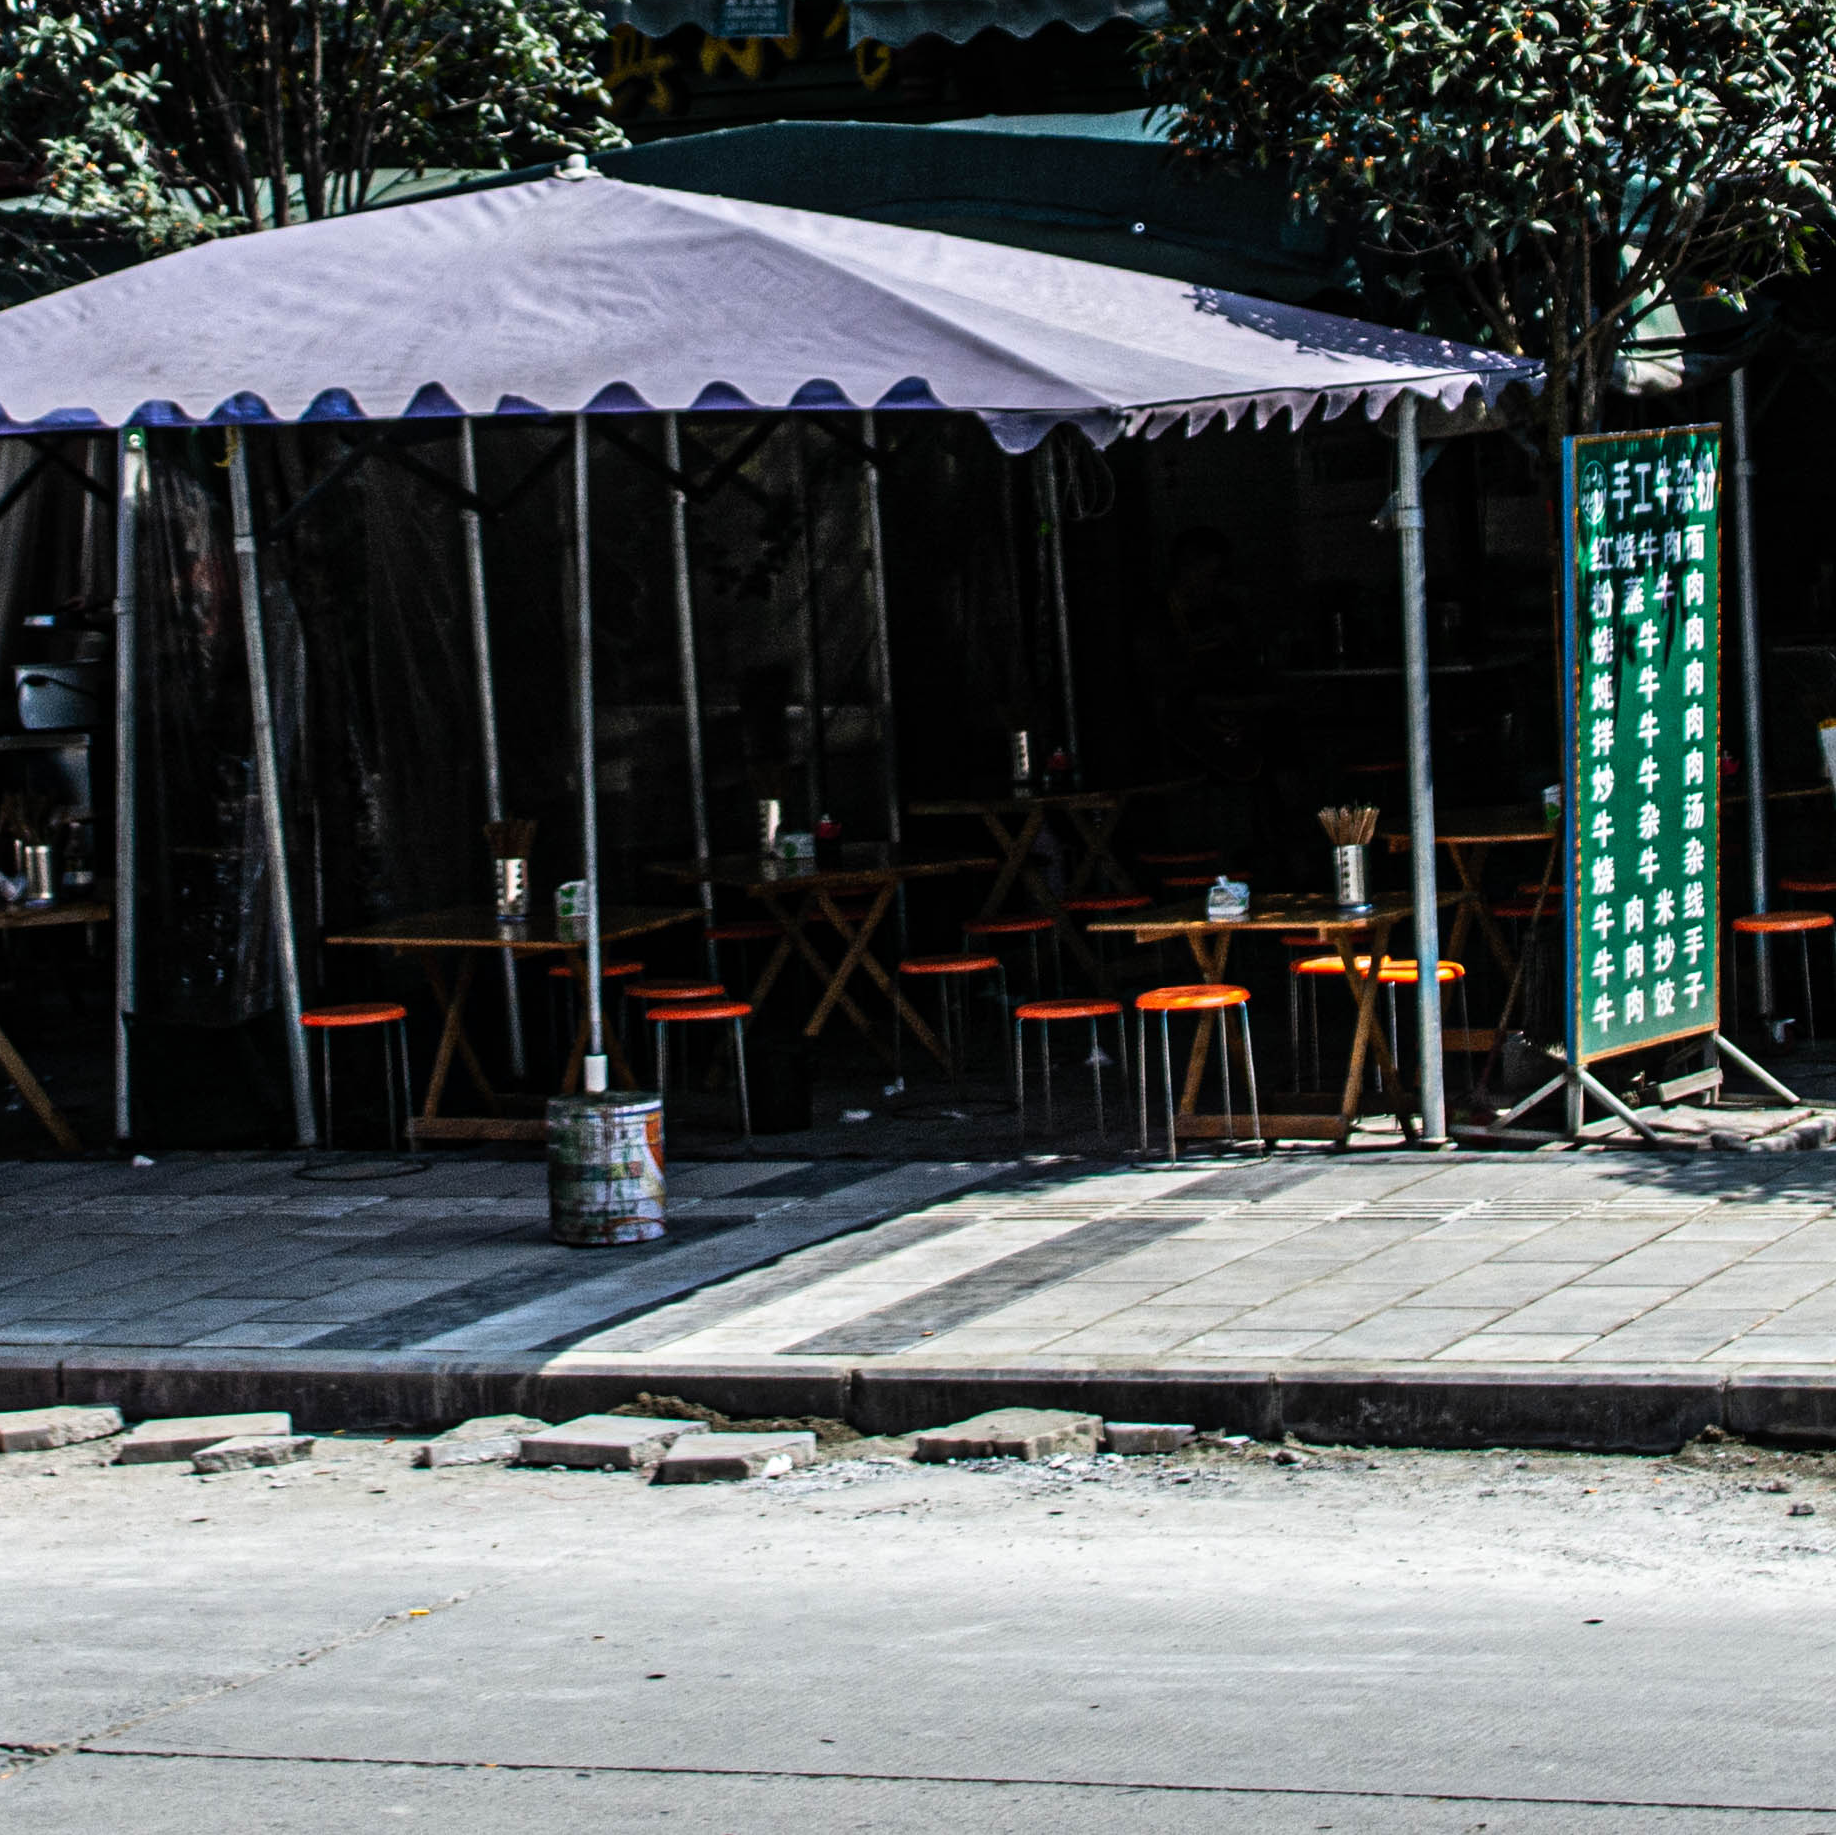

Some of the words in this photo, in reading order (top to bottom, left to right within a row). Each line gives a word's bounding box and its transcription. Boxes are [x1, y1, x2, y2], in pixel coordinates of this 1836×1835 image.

[1612, 451, 1716, 521] 手工牛杂粉
[1589, 524, 1706, 572] 红烧牛肉面
[1589, 568, 1706, 619] 粉蒸牛肉
[1589, 613, 1706, 665] 烧牛肉
[1589, 657, 1706, 712] 炖牛肉
[1589, 702, 1706, 757] 拌牛肉
[1589, 747, 1706, 804] 炒牛肉
[1589, 791, 1706, 849] 牛杂汤
[1589, 836, 1706, 895] 烧牛杂
[1589, 881, 1706, 941] 牛肉米线
[1589, 925, 1706, 987] 牛肉抄手
[1589, 970, 1706, 1033] 牛肉饺子
